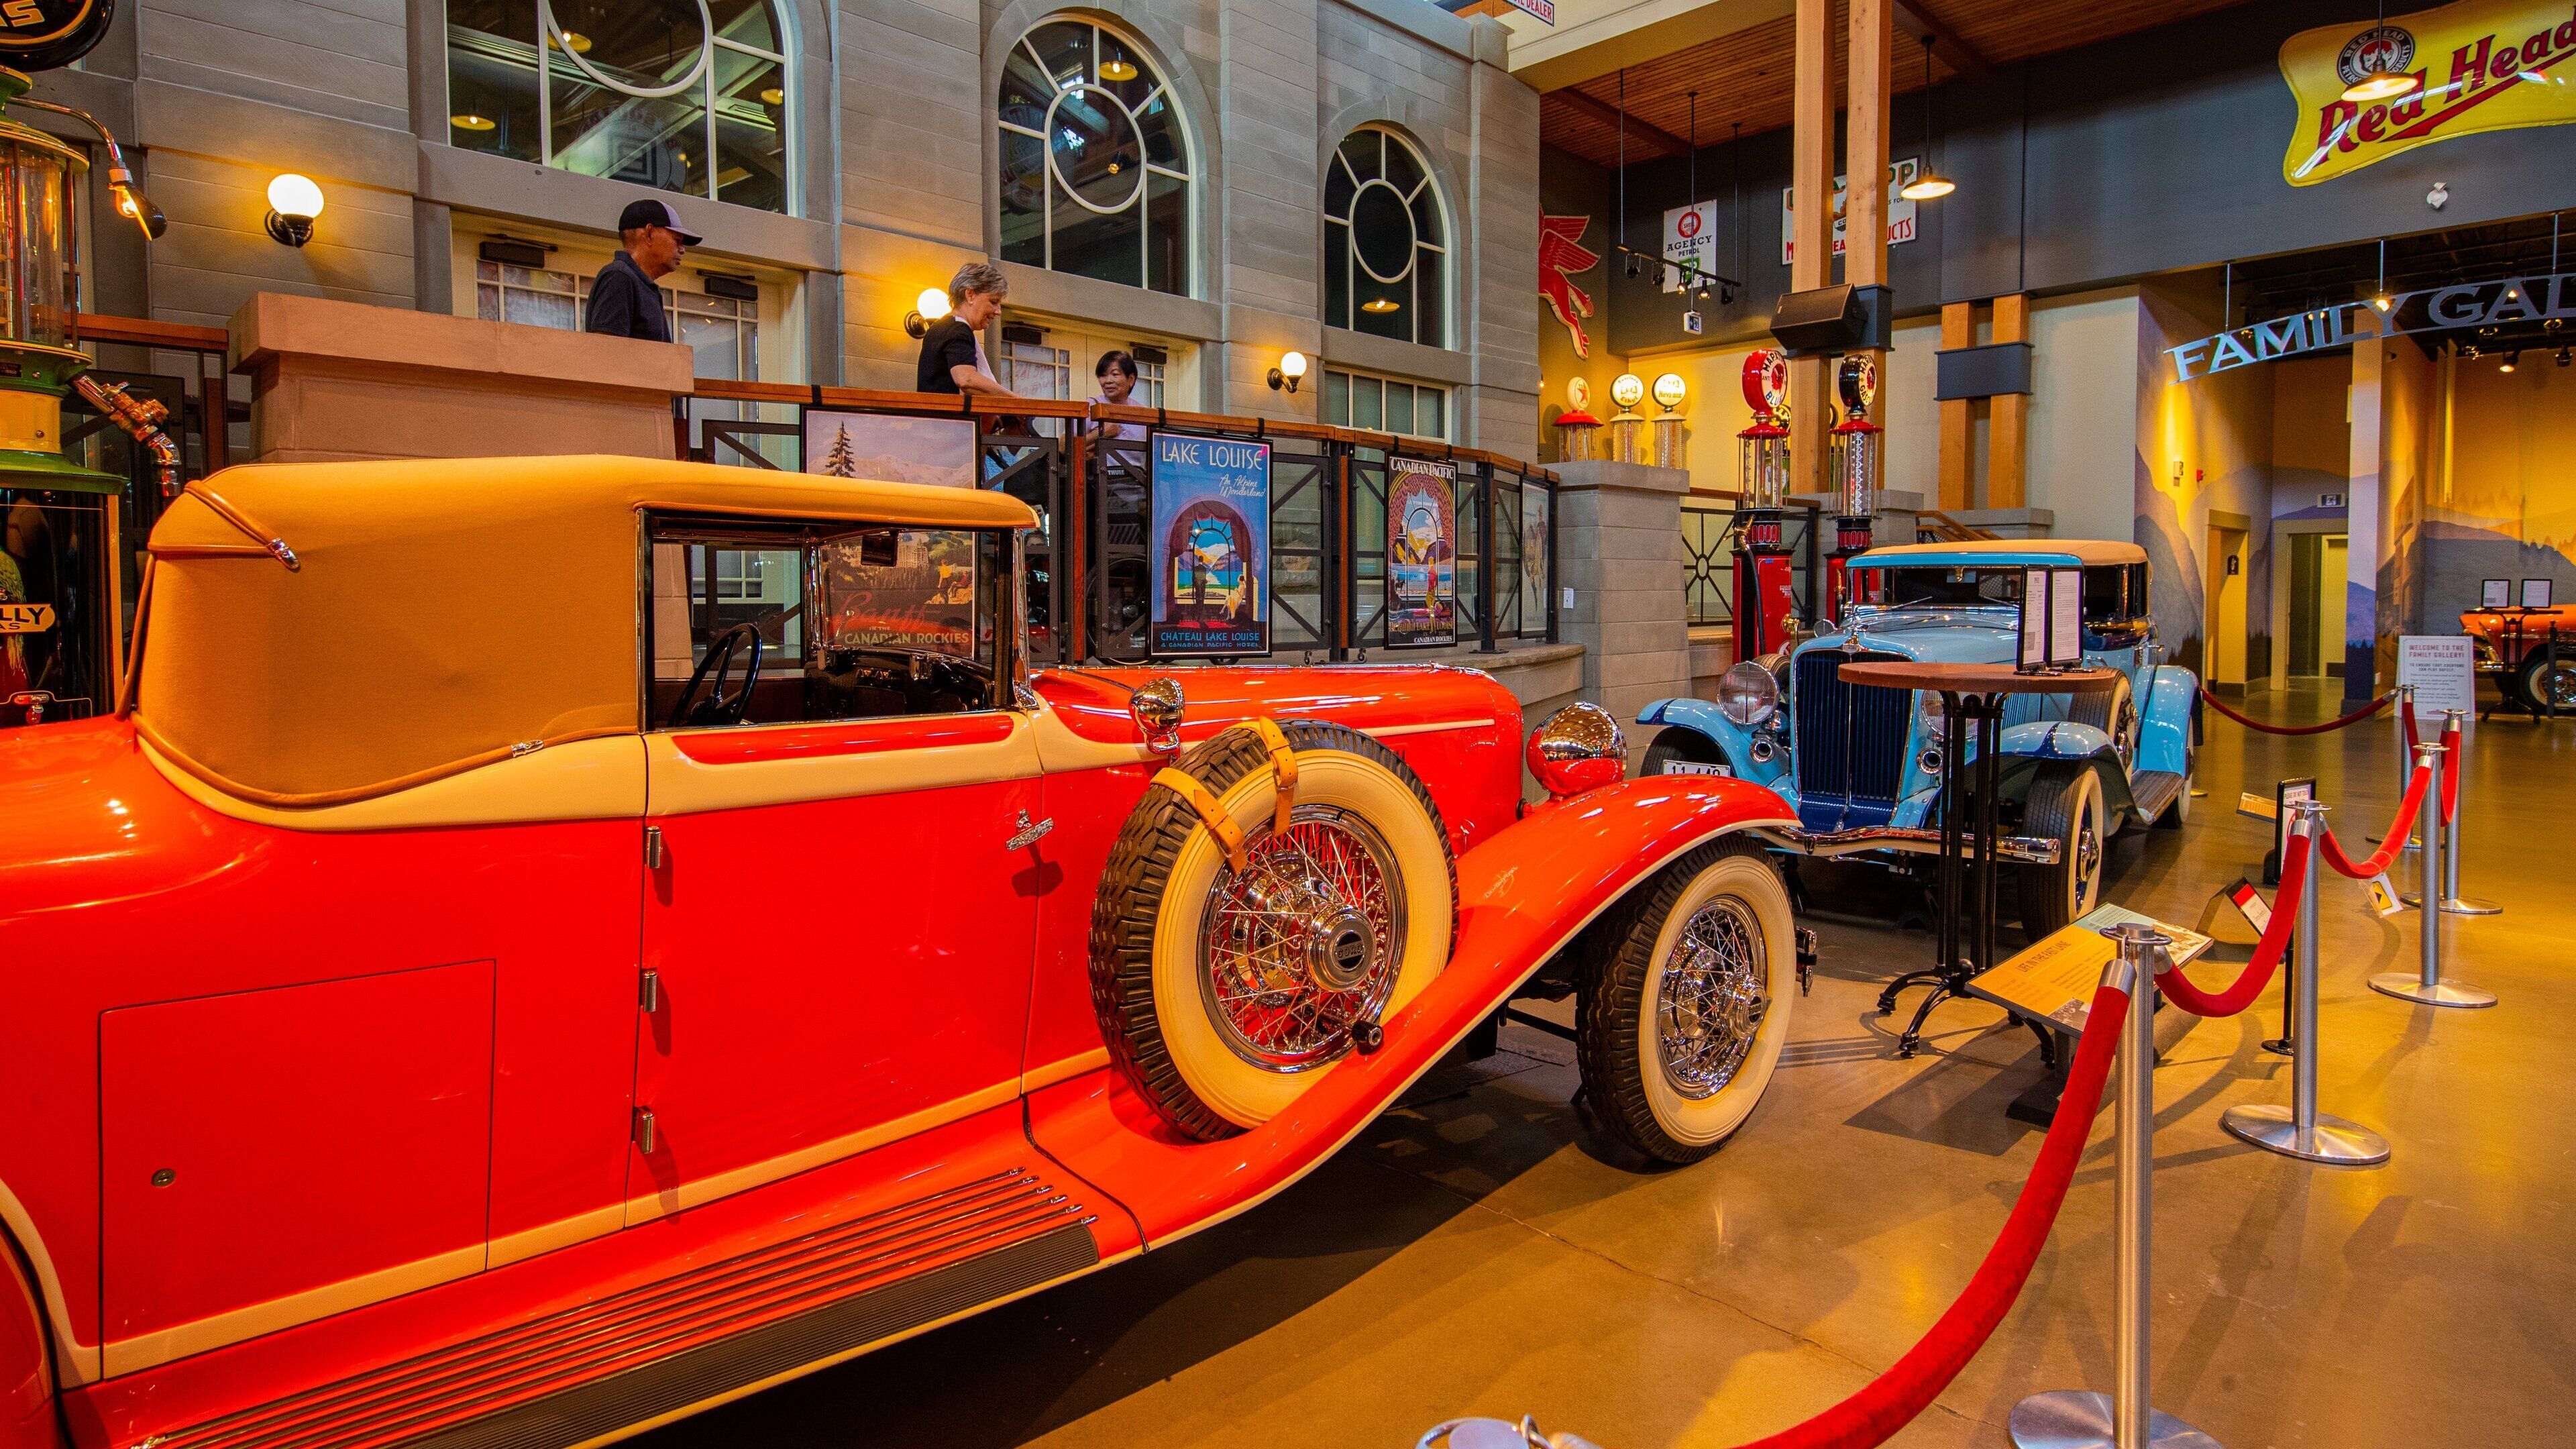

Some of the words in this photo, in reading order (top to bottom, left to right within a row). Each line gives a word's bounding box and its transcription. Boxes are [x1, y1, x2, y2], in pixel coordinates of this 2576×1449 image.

[2344, 36, 2368, 58] RED
[2389, 44, 2410, 72] ODUCTS
[2314, 67, 2427, 167] Red
[2444, 5, 2576, 104] Head
[1666, 235, 1712, 252] AGENCY
[1678, 248, 1700, 257] PETROL
[2163, 292, 2413, 384] FAMILY
[1163, 441, 1200, 464] LAKE
[1210, 445, 1263, 470] LOUISE
[1391, 458, 1429, 474] CANADIAN
[1429, 463, 1454, 479] PACIFIC
[1219, 474, 1230, 487] An
[1234, 474, 1258, 490] Alpine
[1220, 486, 1265, 498] Wonderland
[845, 633, 910, 645] CANADIAN
[916, 633, 969, 644] ROCKIES
[1205, 633, 1228, 641] LAKE
[1232, 633, 1259, 641] LOUISE
[1338, 944, 1362, 958] CORD
[2015, 963, 2034, 973] LIFE
[2055, 940, 2072, 951] LANE
